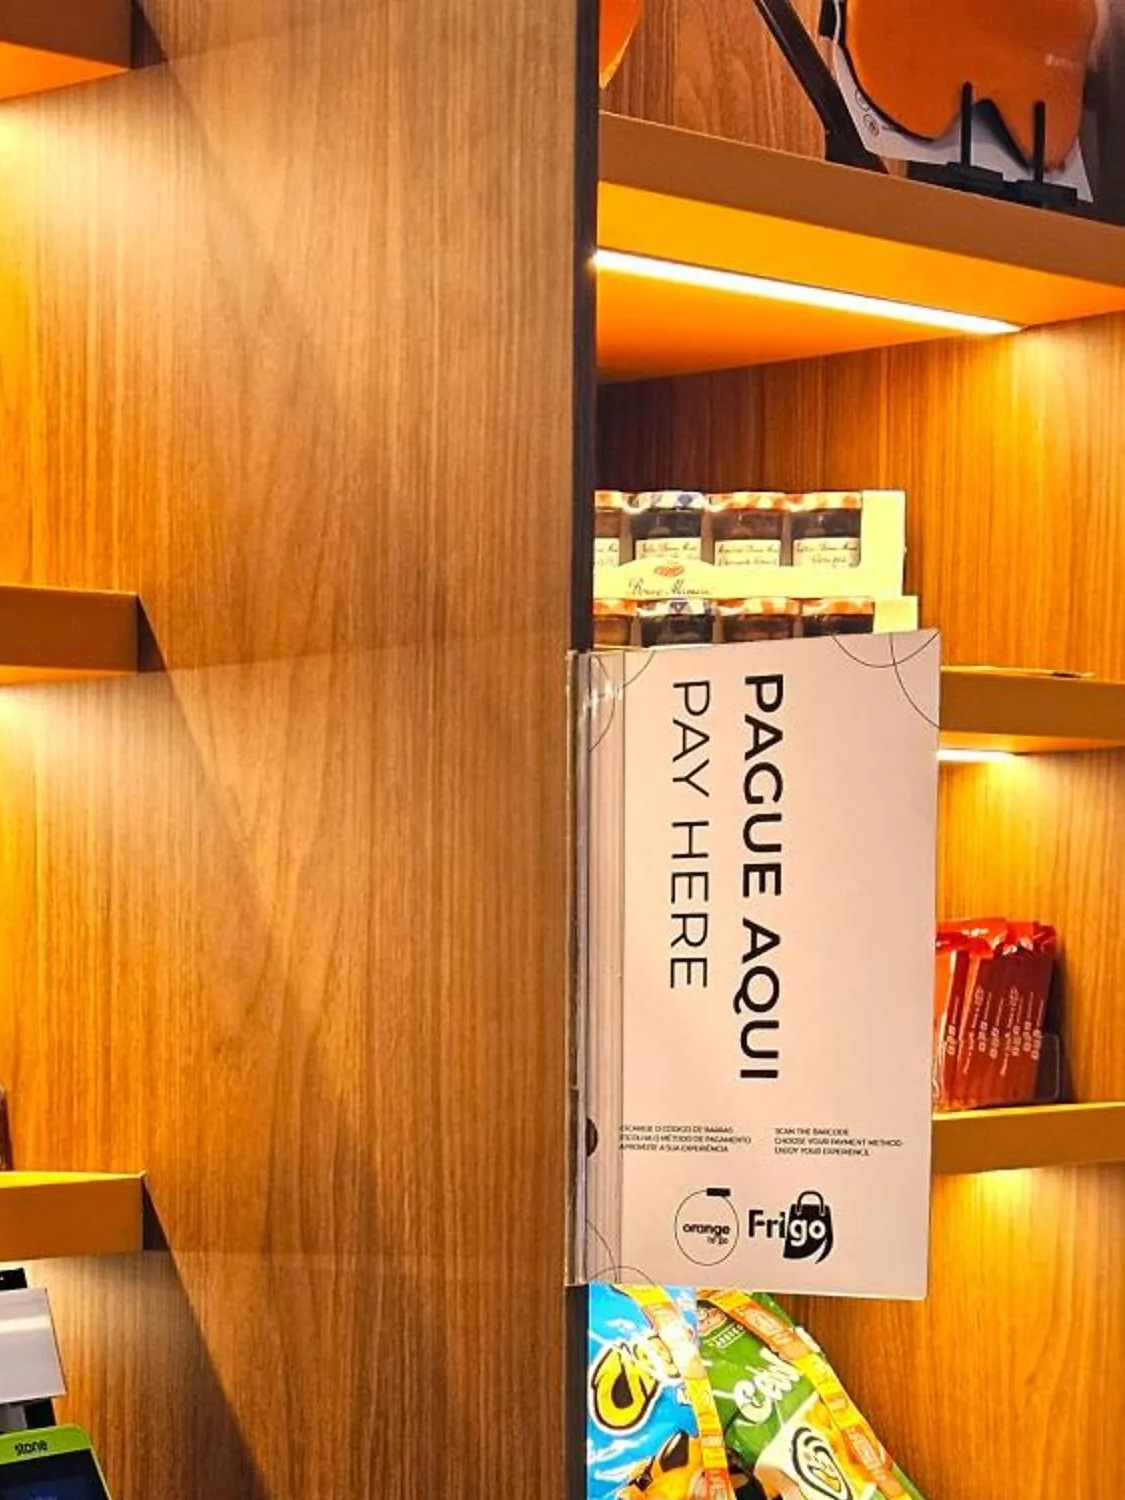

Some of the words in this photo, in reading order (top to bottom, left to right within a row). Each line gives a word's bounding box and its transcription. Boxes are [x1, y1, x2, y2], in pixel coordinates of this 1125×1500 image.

[672, 679, 712, 798] PAY
[742, 674, 785, 898] PAGUE
[670, 820, 710, 989] HERE
[733, 917, 783, 1079] AQUI
[682, 1222, 731, 1236] orange
[748, 1209, 826, 1247] Frigo
[14, 1439, 49, 1457] stone
